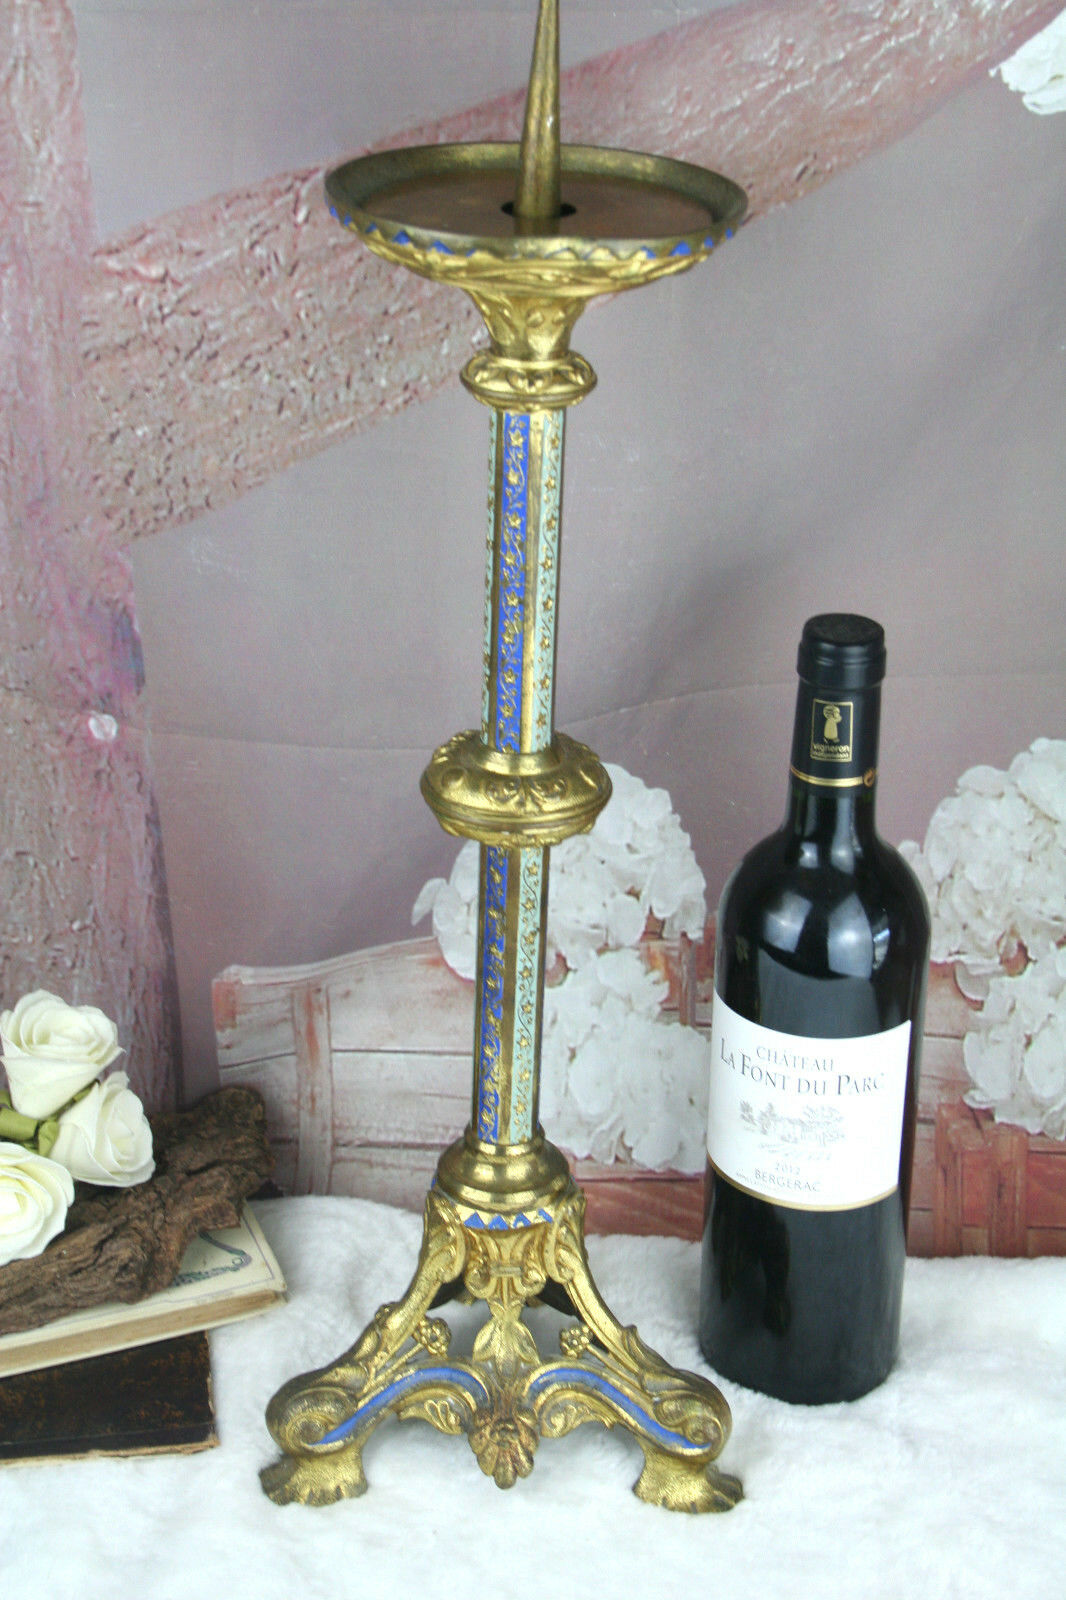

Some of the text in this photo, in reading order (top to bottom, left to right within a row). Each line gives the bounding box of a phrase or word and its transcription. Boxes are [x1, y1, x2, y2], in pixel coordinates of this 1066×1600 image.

[720, 1037, 885, 1096] LA FONT DU PARC
[756, 1044, 834, 1071] CHÂTEAU
[754, 1168, 823, 1192] BERGERAC
